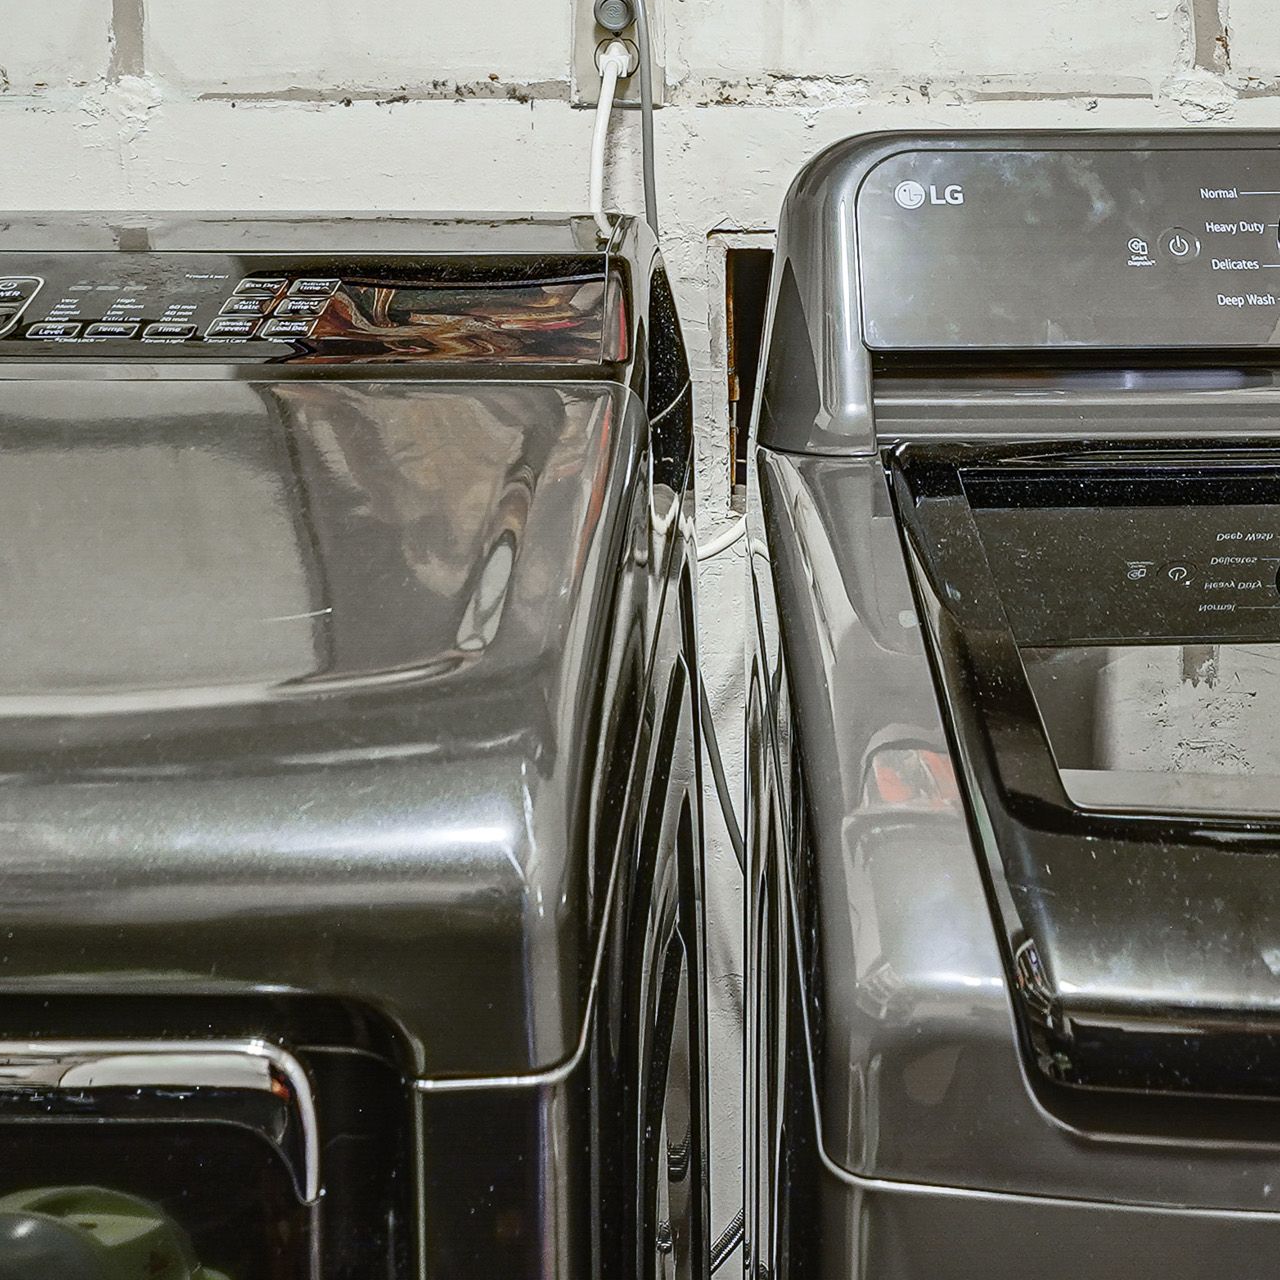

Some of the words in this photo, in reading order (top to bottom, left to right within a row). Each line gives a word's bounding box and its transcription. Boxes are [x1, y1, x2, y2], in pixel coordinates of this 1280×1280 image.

[929, 184, 964, 205] LG
[1200, 187, 1238, 199] Normal
[1205, 221, 1237, 235] Heavy
[1239, 221, 1264, 234] Duty
[1211, 258, 1260, 271] Delicates
[1217, 294, 1245, 308] Deep
[1246, 293, 1276, 306] Wash
